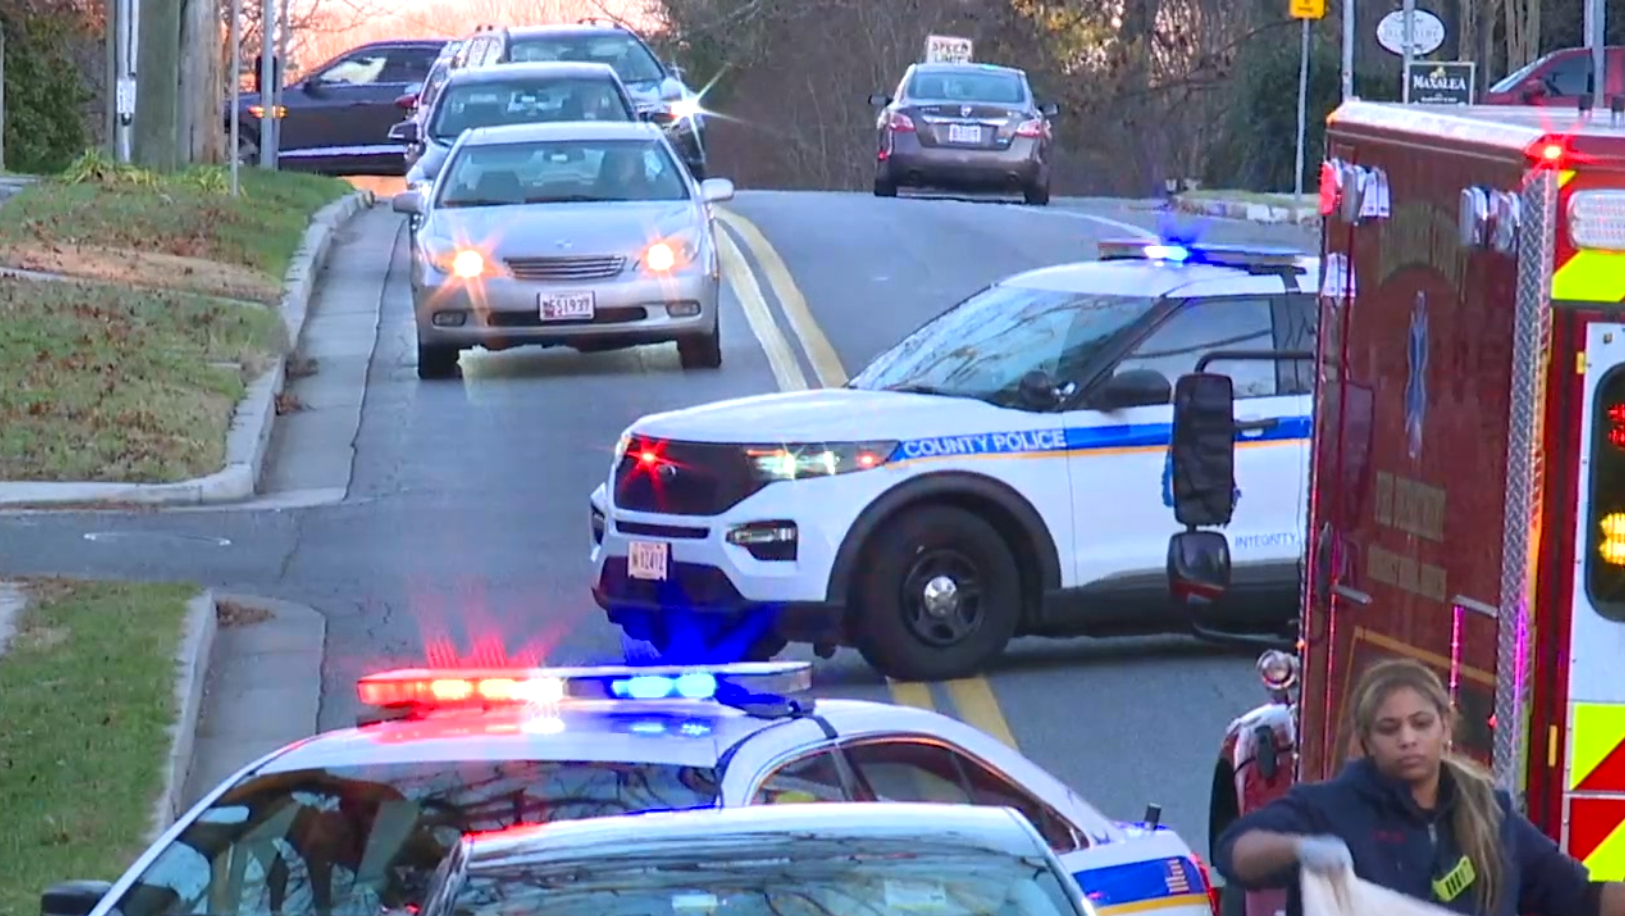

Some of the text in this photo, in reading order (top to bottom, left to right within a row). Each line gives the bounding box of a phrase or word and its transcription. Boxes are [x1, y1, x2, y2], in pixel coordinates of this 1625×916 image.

[931, 42, 969, 52] SPEED
[1413, 74, 1466, 90] MAXALEA
[903, 429, 1067, 457] COUNTY POLICE
[1235, 532, 1296, 549] INTEGRITY
